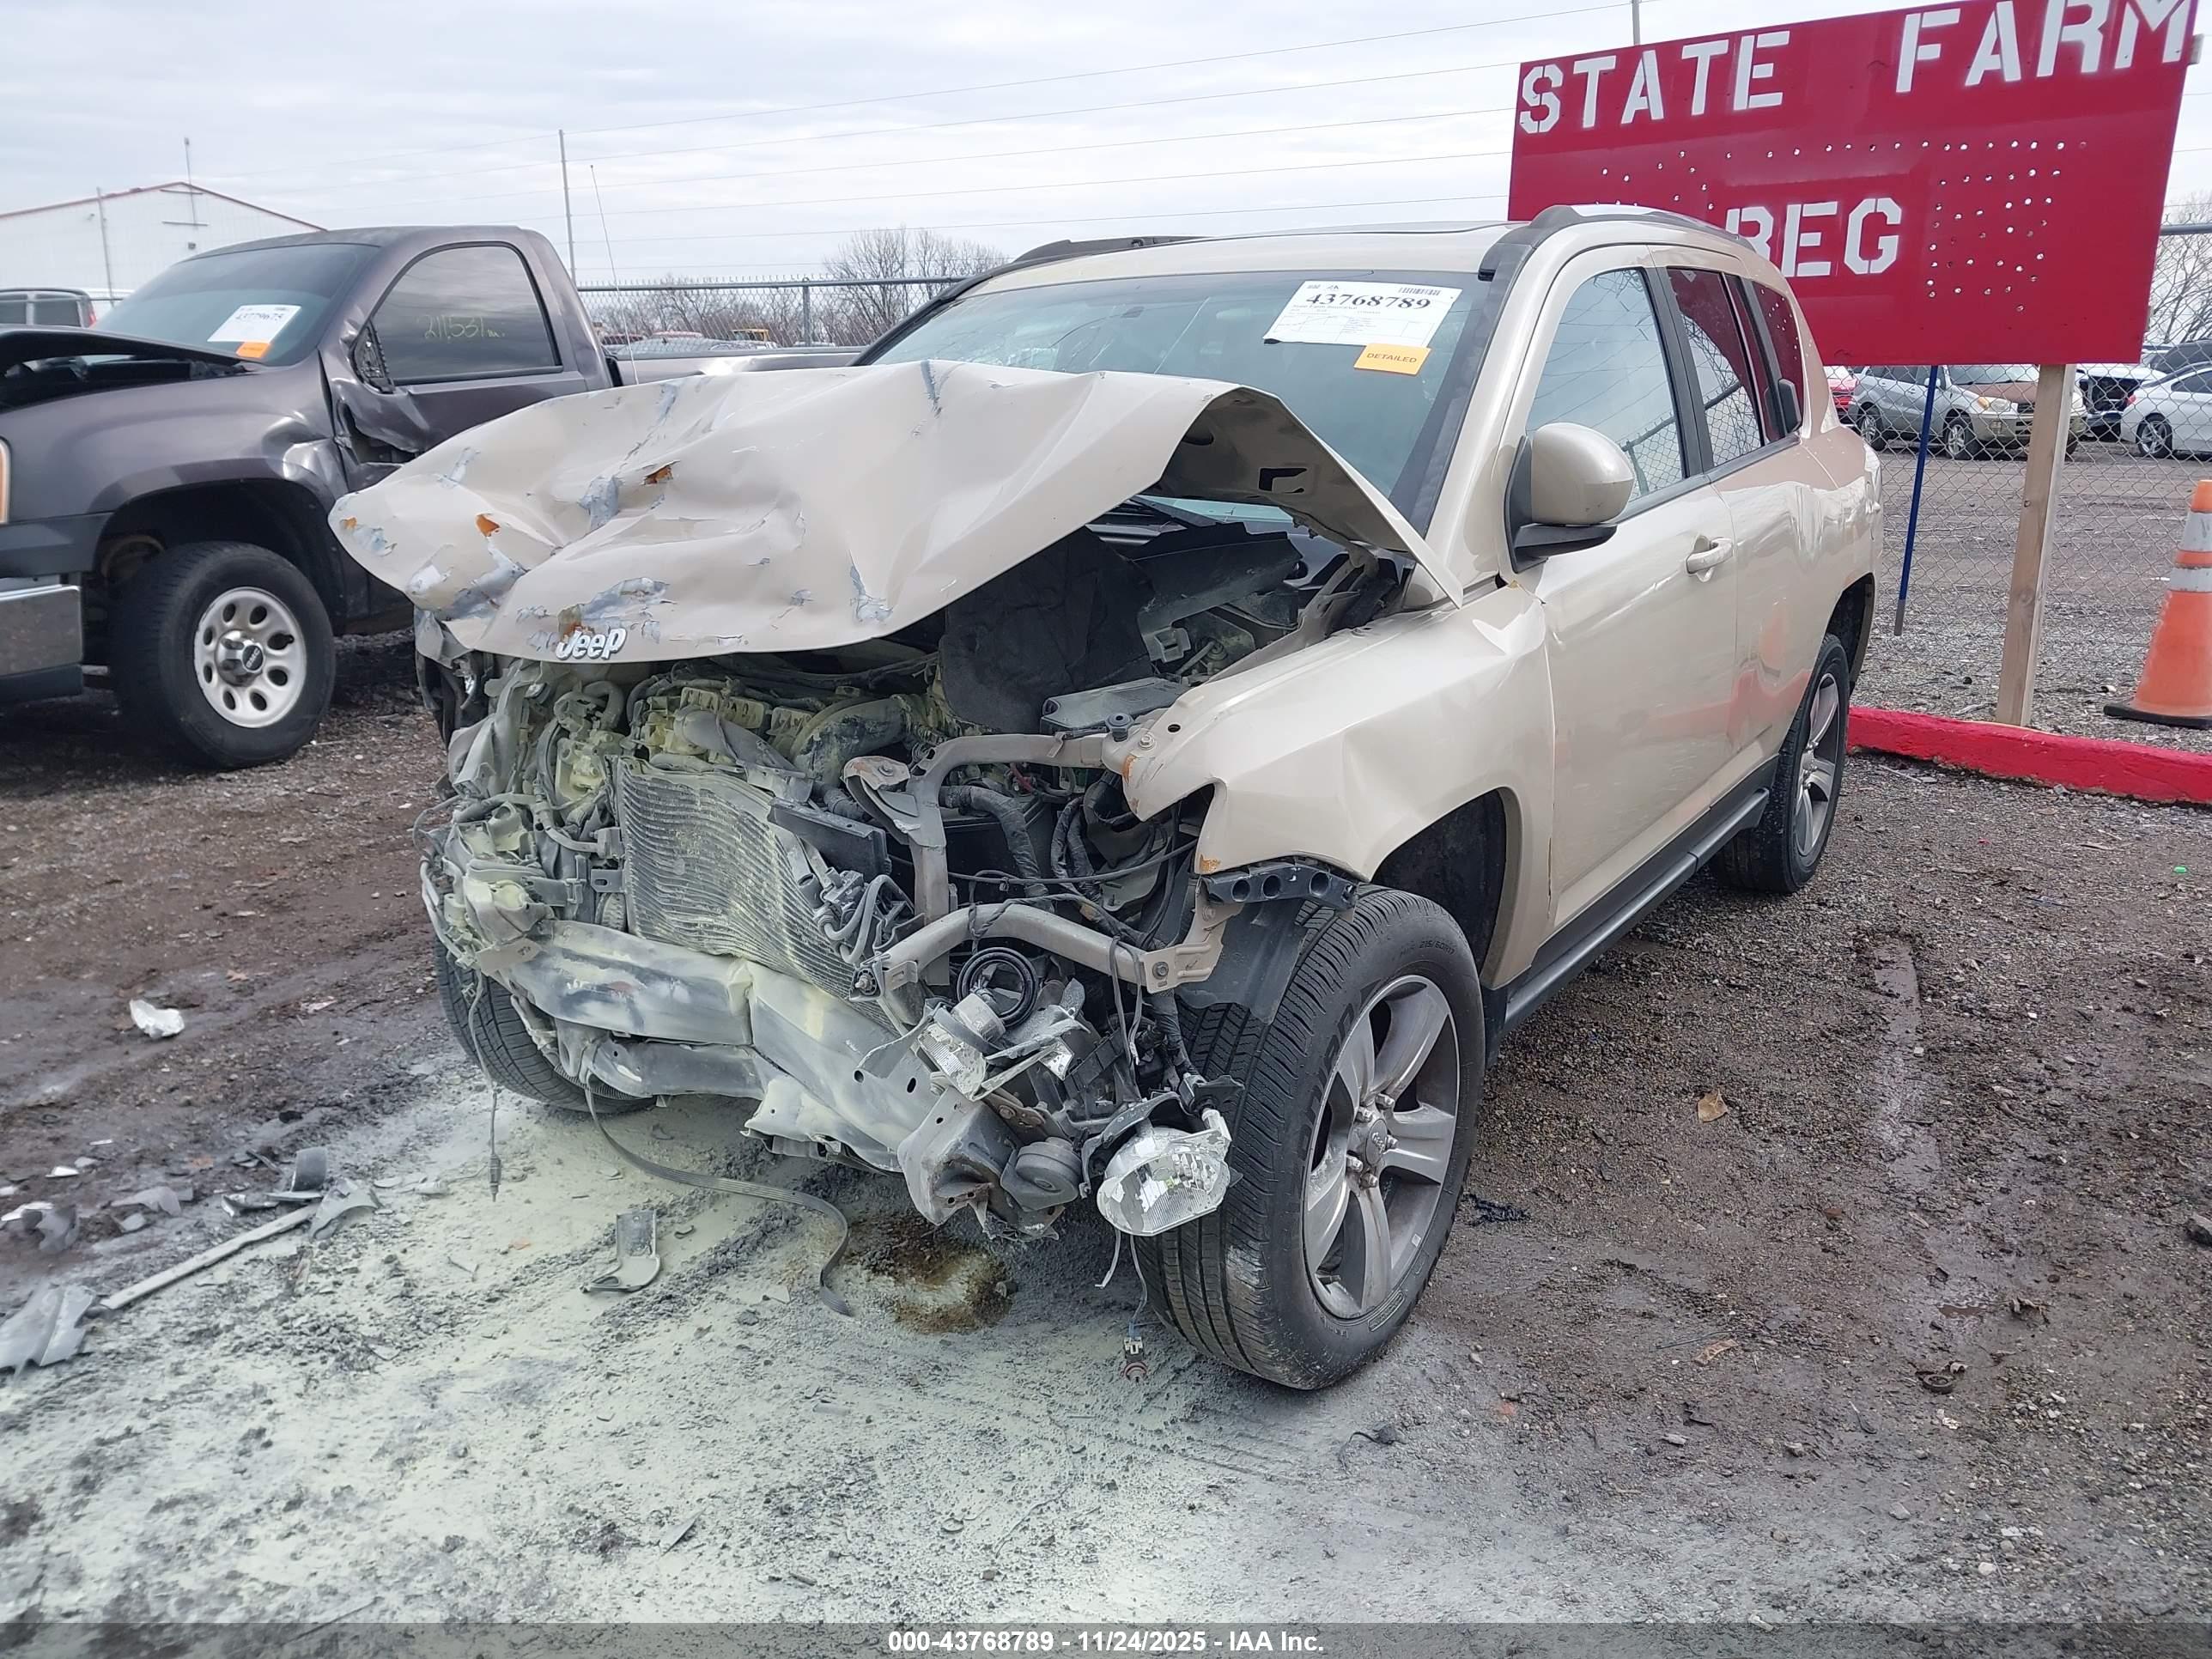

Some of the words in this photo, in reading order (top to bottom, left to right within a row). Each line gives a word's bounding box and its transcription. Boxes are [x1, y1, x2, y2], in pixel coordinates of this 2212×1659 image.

[1519, 30, 1791, 135] STATE
[1895, 0, 2191, 94] FARM
[1305, 293, 1432, 310] 43768789
[1366, 351, 1418, 364] DETAILED
[555, 628, 628, 660] Jeep
[246, 647, 260, 669] GMC
